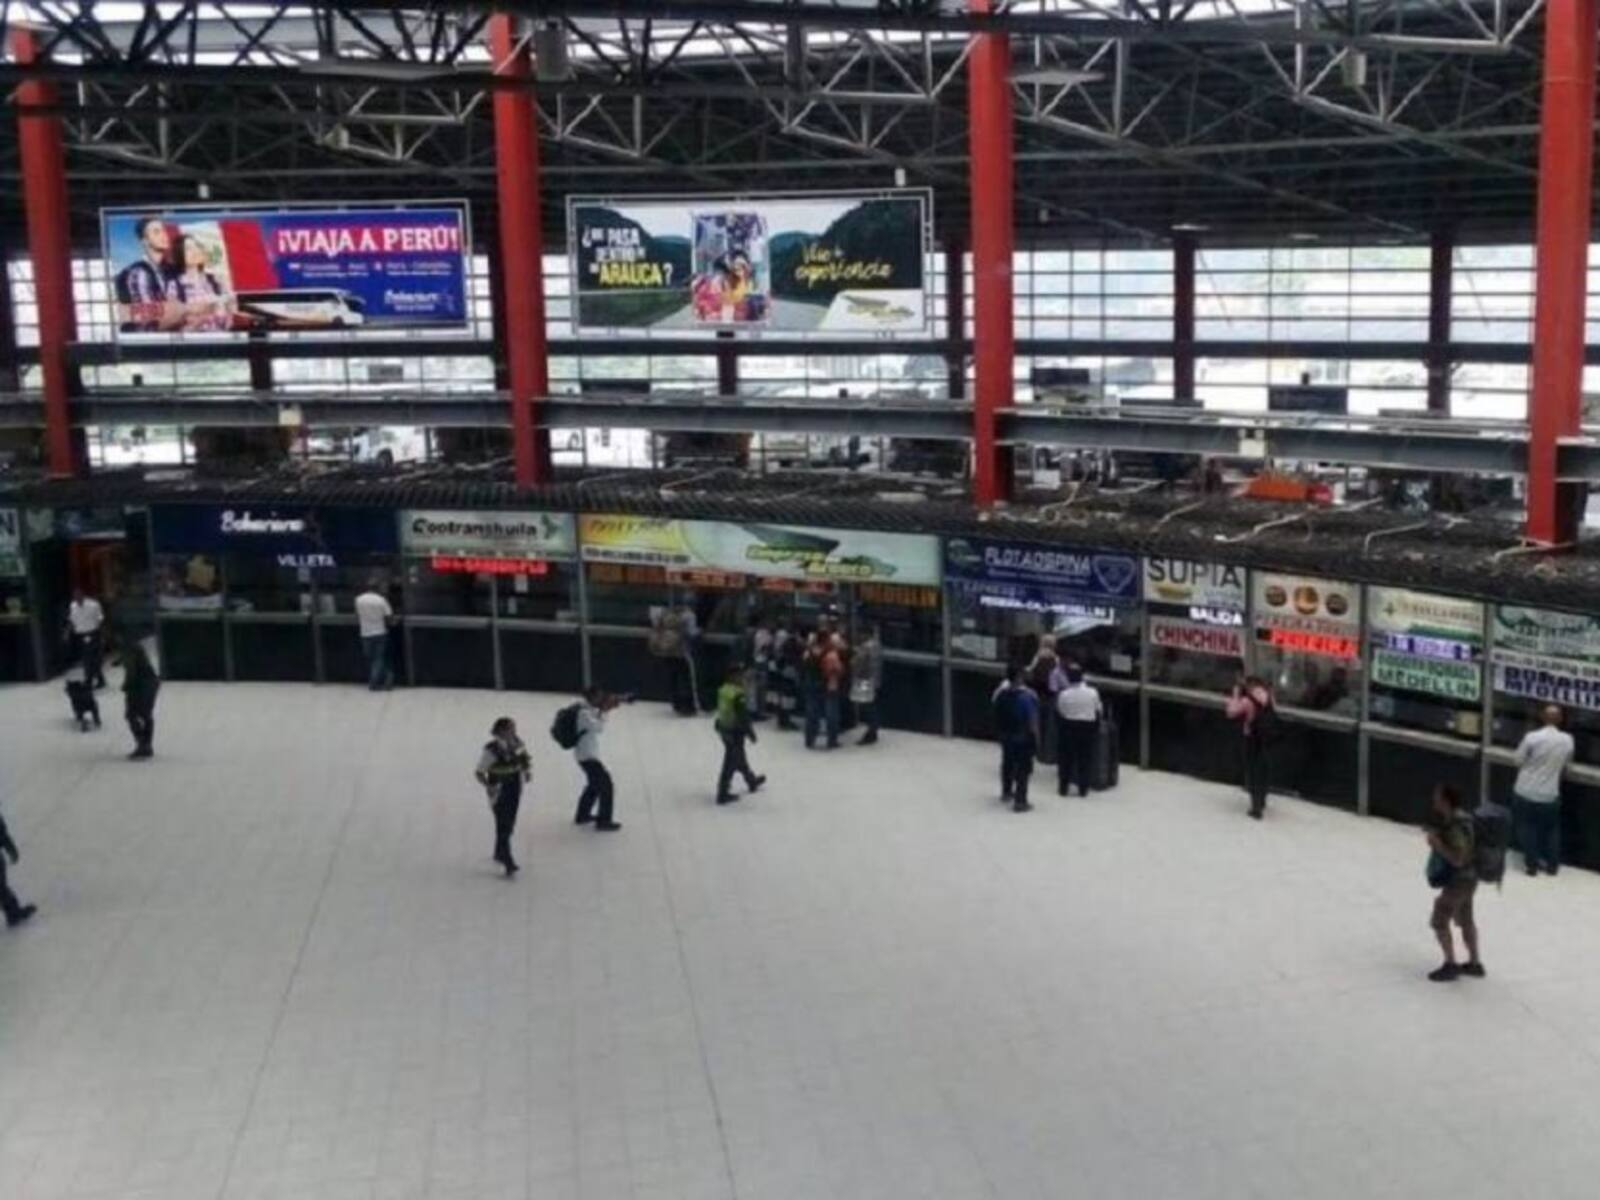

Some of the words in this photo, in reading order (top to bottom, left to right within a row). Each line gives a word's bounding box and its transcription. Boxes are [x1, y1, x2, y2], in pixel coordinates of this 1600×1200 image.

[278, 228, 355, 258] ¡VIAJA
[359, 228, 378, 251] A
[277, 554, 335, 568] VILLETA
